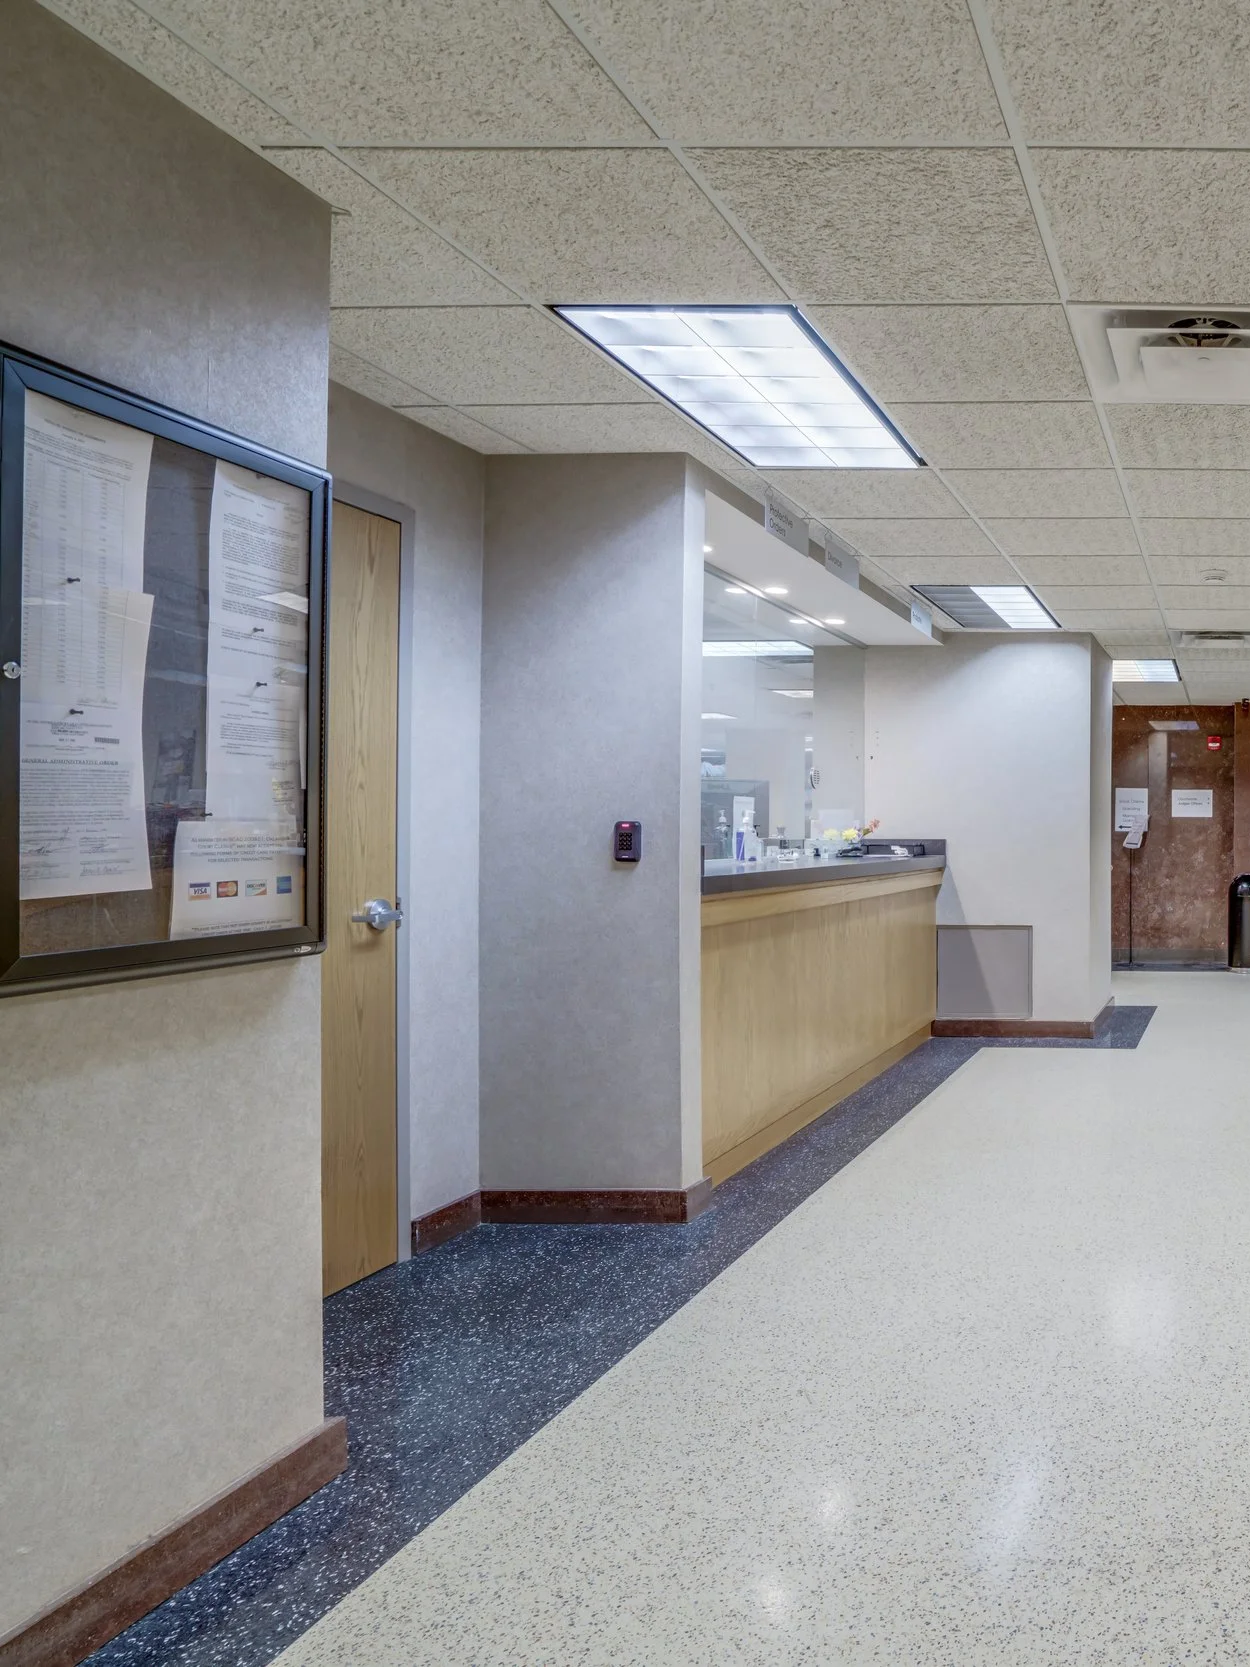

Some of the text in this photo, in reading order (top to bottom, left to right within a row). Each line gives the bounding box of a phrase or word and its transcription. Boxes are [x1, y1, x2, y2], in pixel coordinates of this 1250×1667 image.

[769, 503, 794, 529] Protective
[769, 517, 786, 537] Orders
[828, 551, 843, 568] Divorce
[193, 887, 208, 895] VISA
